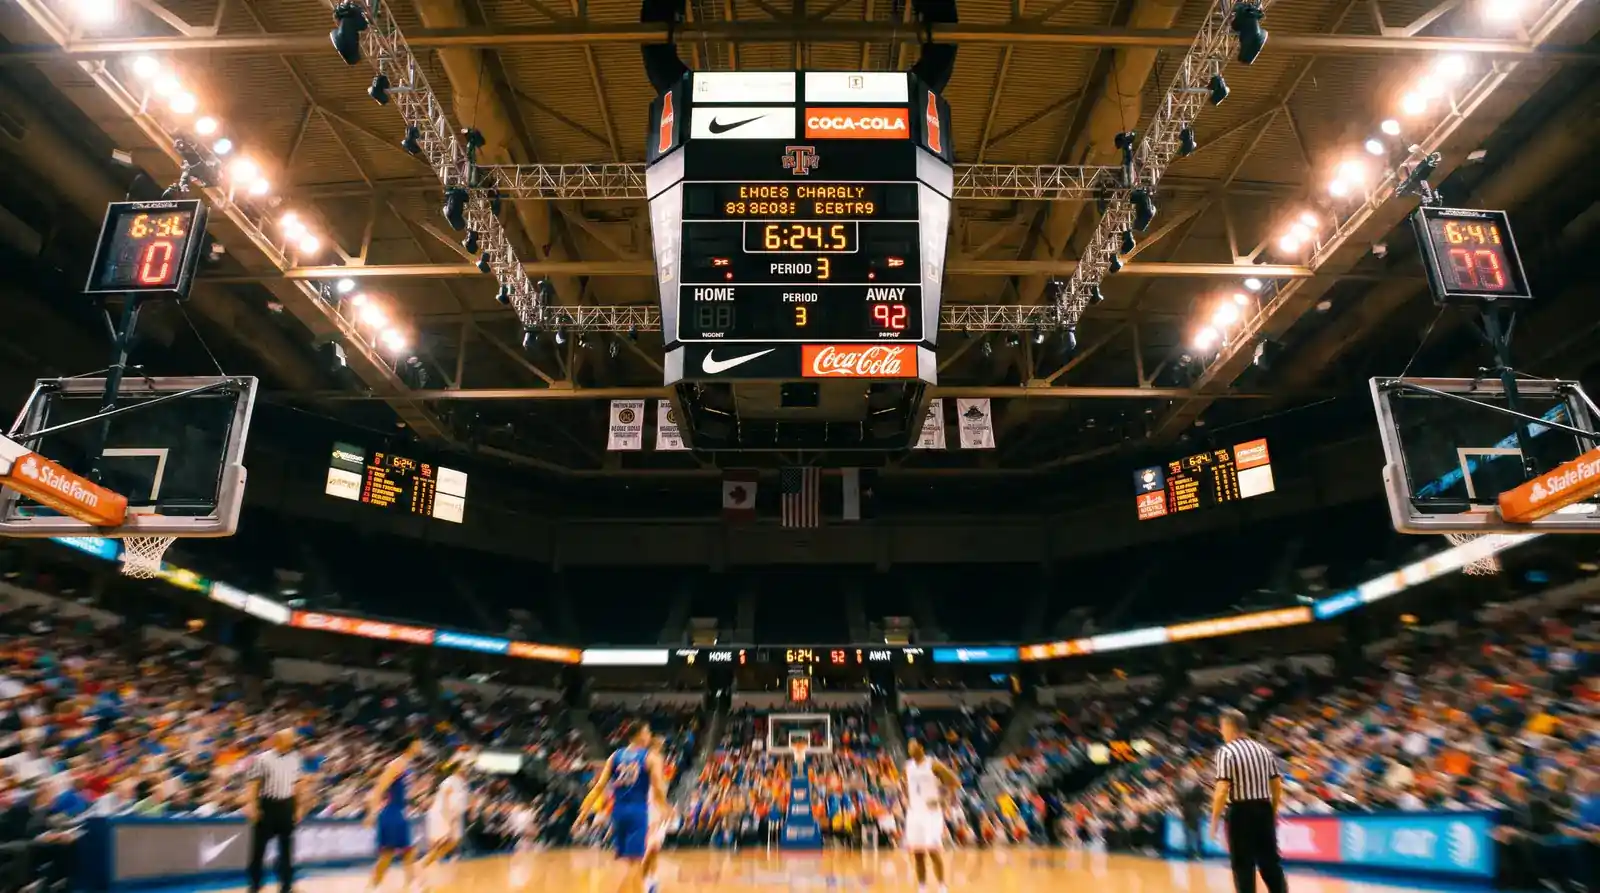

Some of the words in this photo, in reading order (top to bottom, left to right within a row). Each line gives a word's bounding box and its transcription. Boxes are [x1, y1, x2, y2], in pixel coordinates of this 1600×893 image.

[808, 117, 905, 130] COCA-COLA
[765, 225, 846, 249] 6:24.5
[142, 241, 173, 283] 0
[770, 263, 812, 275] PERIOD
[817, 257, 830, 279] 3
[694, 288, 735, 301] HOME
[782, 293, 818, 302] PERIOD
[866, 288, 906, 301] AWAY
[795, 307, 807, 326] 3
[874, 304, 907, 329] 92
[38, 465, 98, 507] StateFarm
